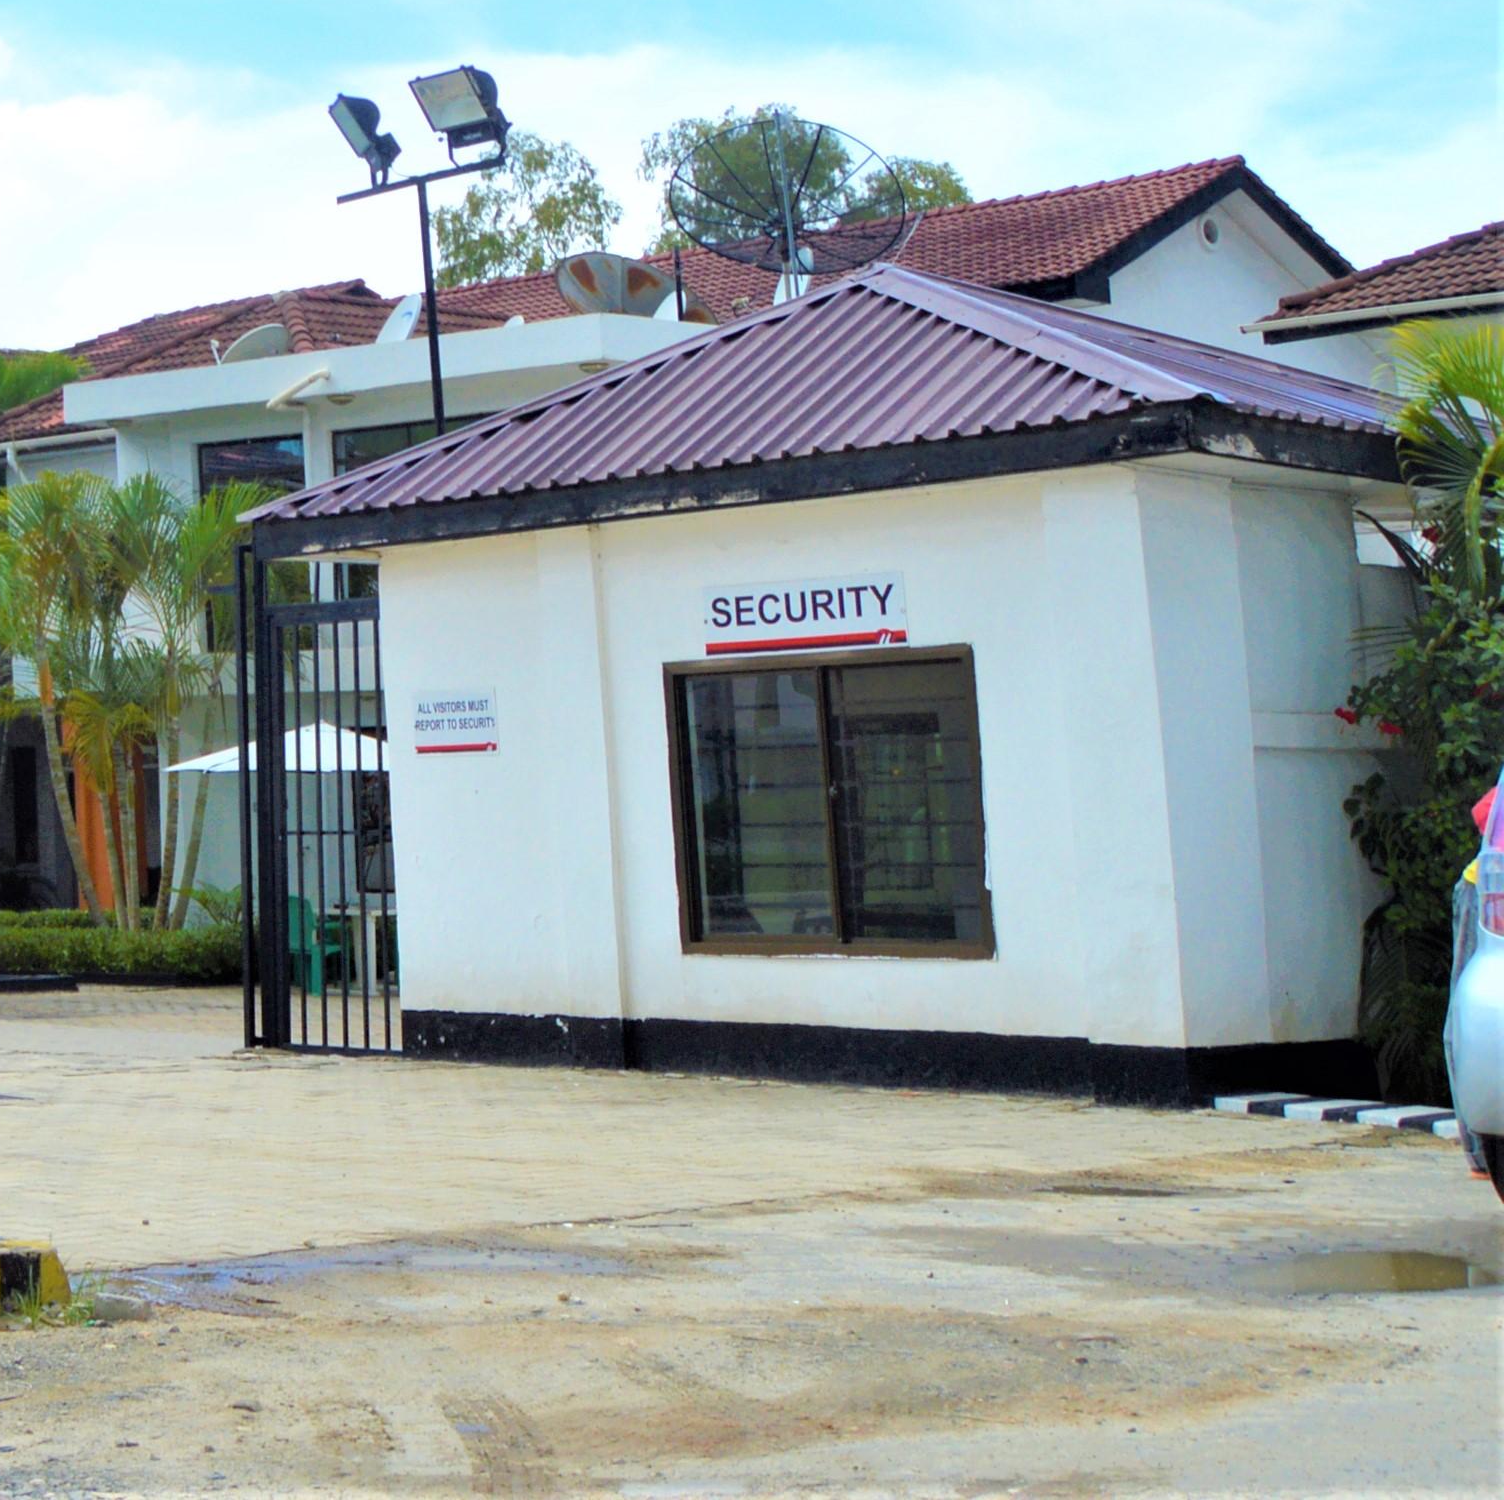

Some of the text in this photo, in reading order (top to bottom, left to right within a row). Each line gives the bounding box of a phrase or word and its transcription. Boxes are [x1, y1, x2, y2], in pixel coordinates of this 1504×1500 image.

[711, 583, 894, 628] SECURITY
[418, 700, 488, 714] ALL VISITORS MUST
[415, 717, 495, 731] REPORT TO SECURITY
